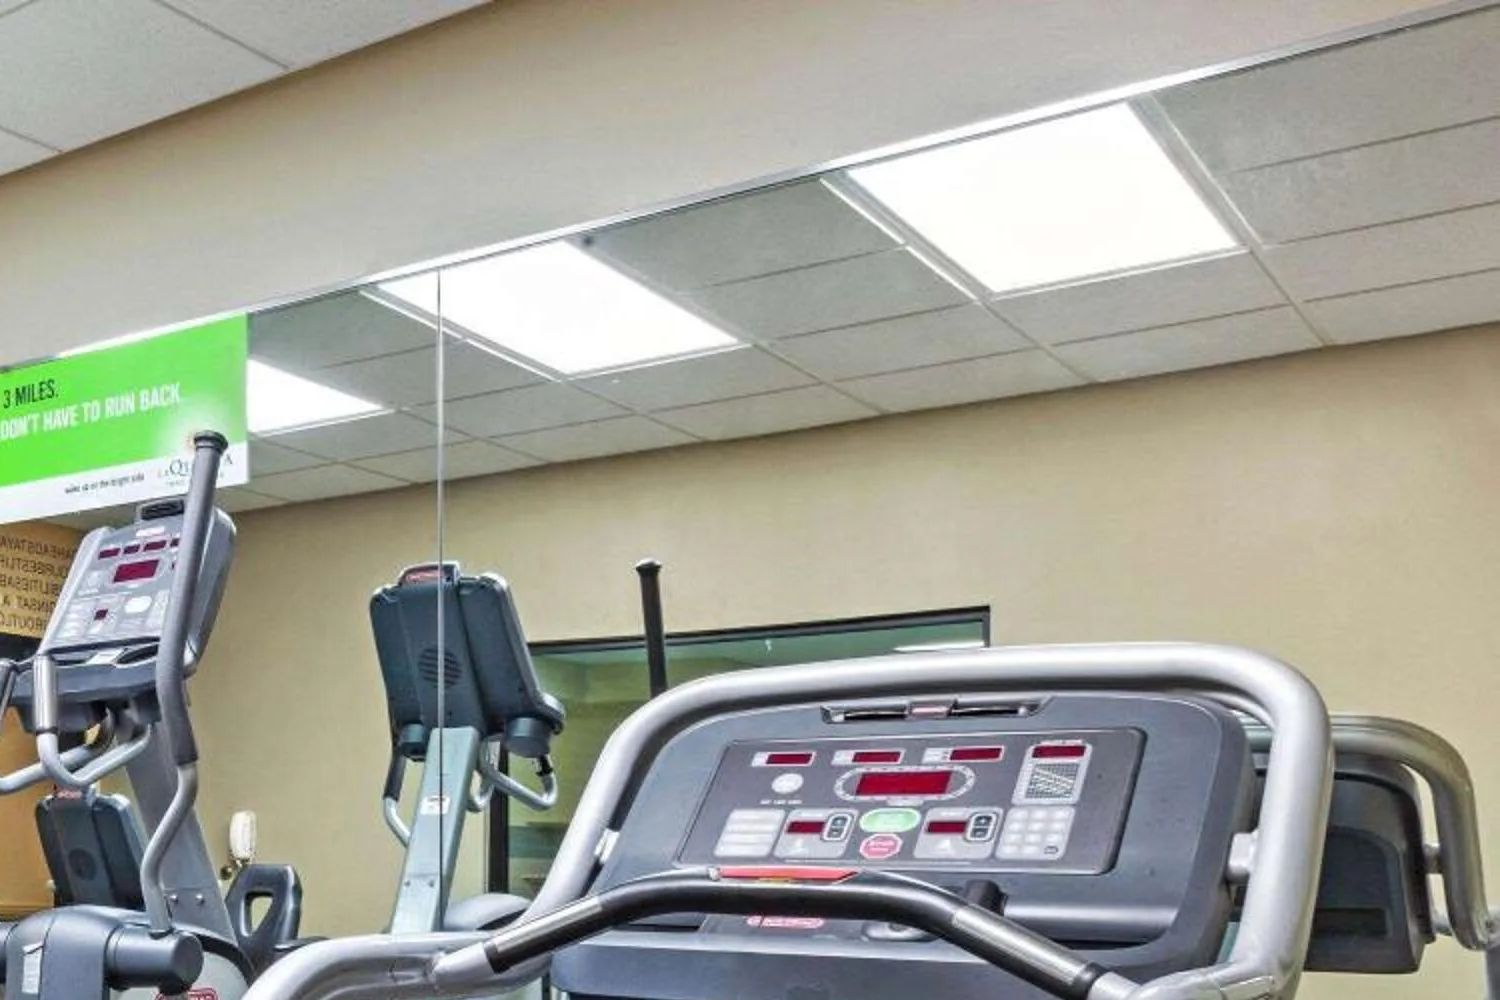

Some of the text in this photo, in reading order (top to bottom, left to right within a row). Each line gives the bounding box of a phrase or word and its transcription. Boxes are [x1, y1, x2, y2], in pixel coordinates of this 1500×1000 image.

[3, 389, 11, 409] 3
[15, 379, 59, 407] MILES.
[43, 404, 78, 431] HAVE
[81, 400, 101, 423] TO
[105, 391, 135, 418] RUN
